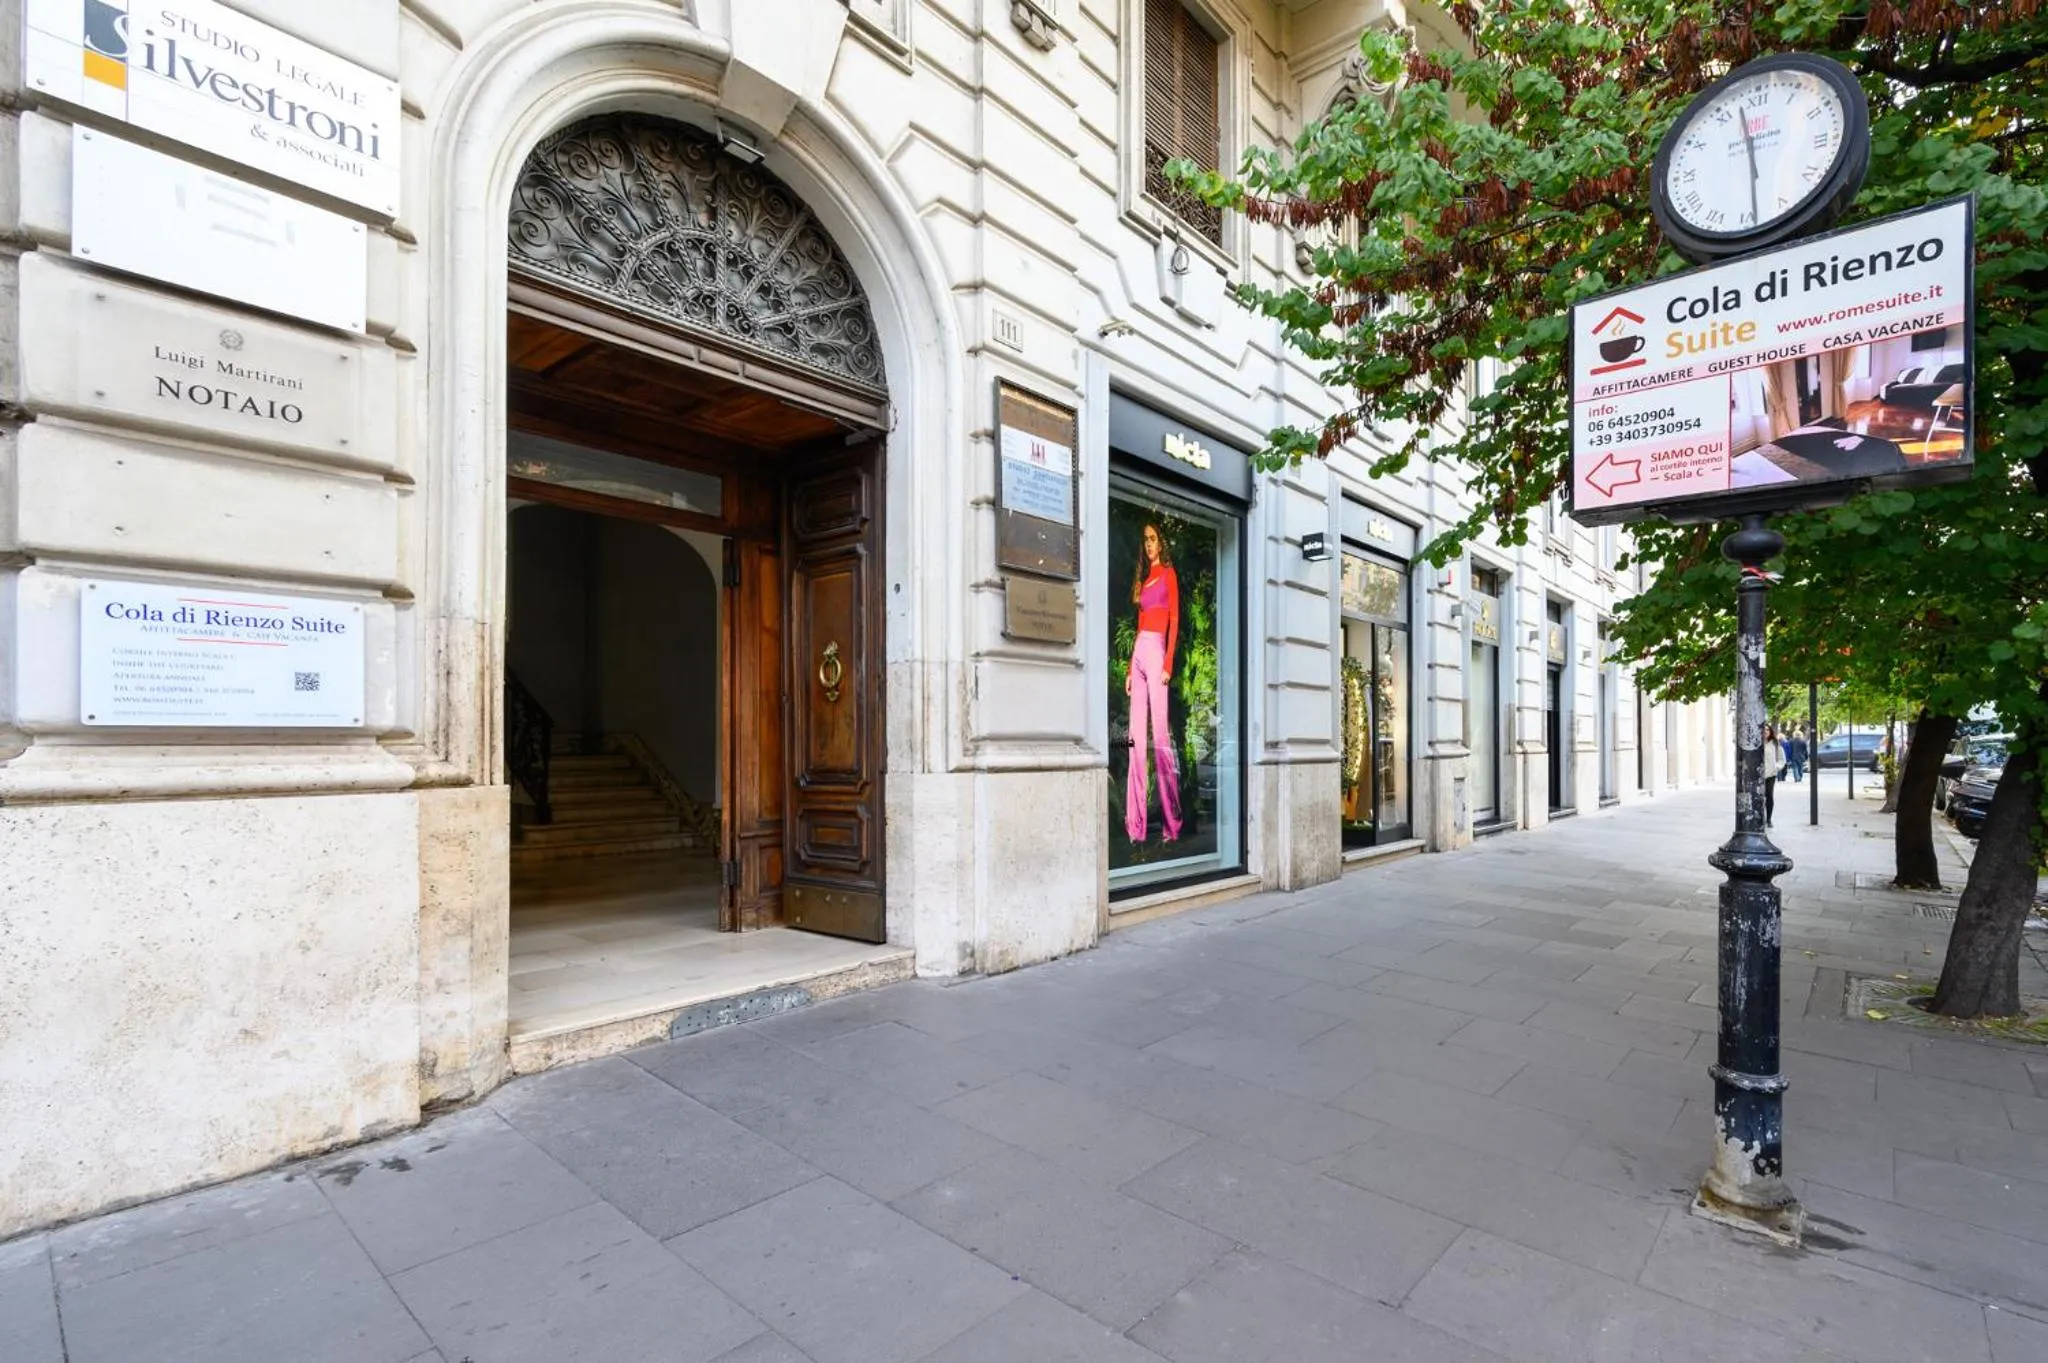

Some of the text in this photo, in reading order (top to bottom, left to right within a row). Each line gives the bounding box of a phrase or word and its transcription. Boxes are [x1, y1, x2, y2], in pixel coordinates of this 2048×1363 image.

[160, 9, 366, 108] STUDIO LEGALE
[84, 14, 381, 160] Silvestroni
[250, 123, 364, 178] & associati
[1666, 237, 1944, 325] Cola di Rienzo
[1777, 284, 1943, 335] www.romesuite.it
[1001, 319, 1017, 342] 111
[1666, 318, 1757, 359] Suite
[154, 345, 303, 390] Luigi Martirani
[1592, 312, 1945, 397] AFFITTACAMERE GUEST HOUSE CASA VACANZE
[155, 376, 304, 423] NOTAIO
[1588, 403, 1618, 418] info:
[1588, 407, 1675, 432] 06 64520904
[1589, 417, 1702, 447] +39 3403730954
[1650, 441, 1723, 462] SIAMO QUI
[1650, 465, 1659, 473] al
[1663, 467, 1704, 482] Scala C
[105, 601, 346, 634] Cola di Rienzo Suite
